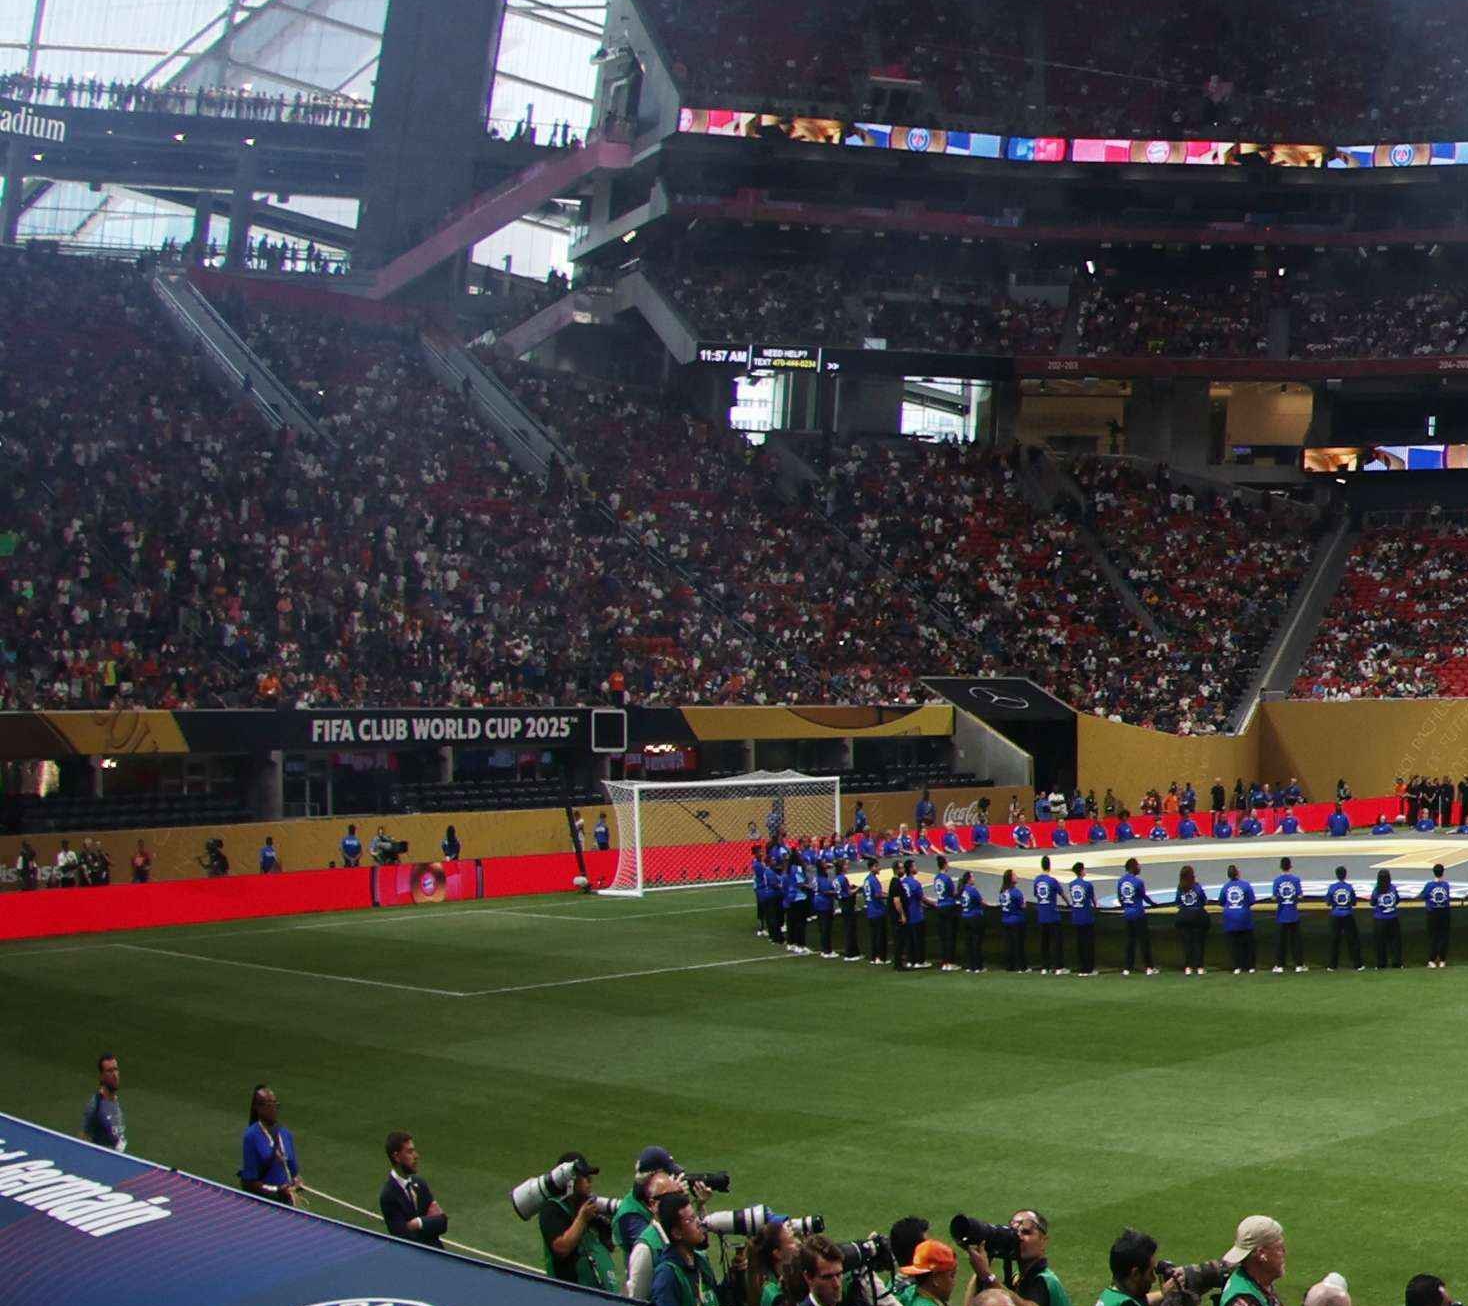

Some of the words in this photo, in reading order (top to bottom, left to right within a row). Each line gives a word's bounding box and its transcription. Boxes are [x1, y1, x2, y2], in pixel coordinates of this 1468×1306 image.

[0, 107, 66, 143] adium
[700, 349, 727, 362] 11:57
[729, 350, 748, 364] AM
[312, 720, 355, 743] FIFA
[358, 719, 408, 743] CLUB
[413, 718, 481, 742] WORLD
[485, 717, 521, 741] CUP
